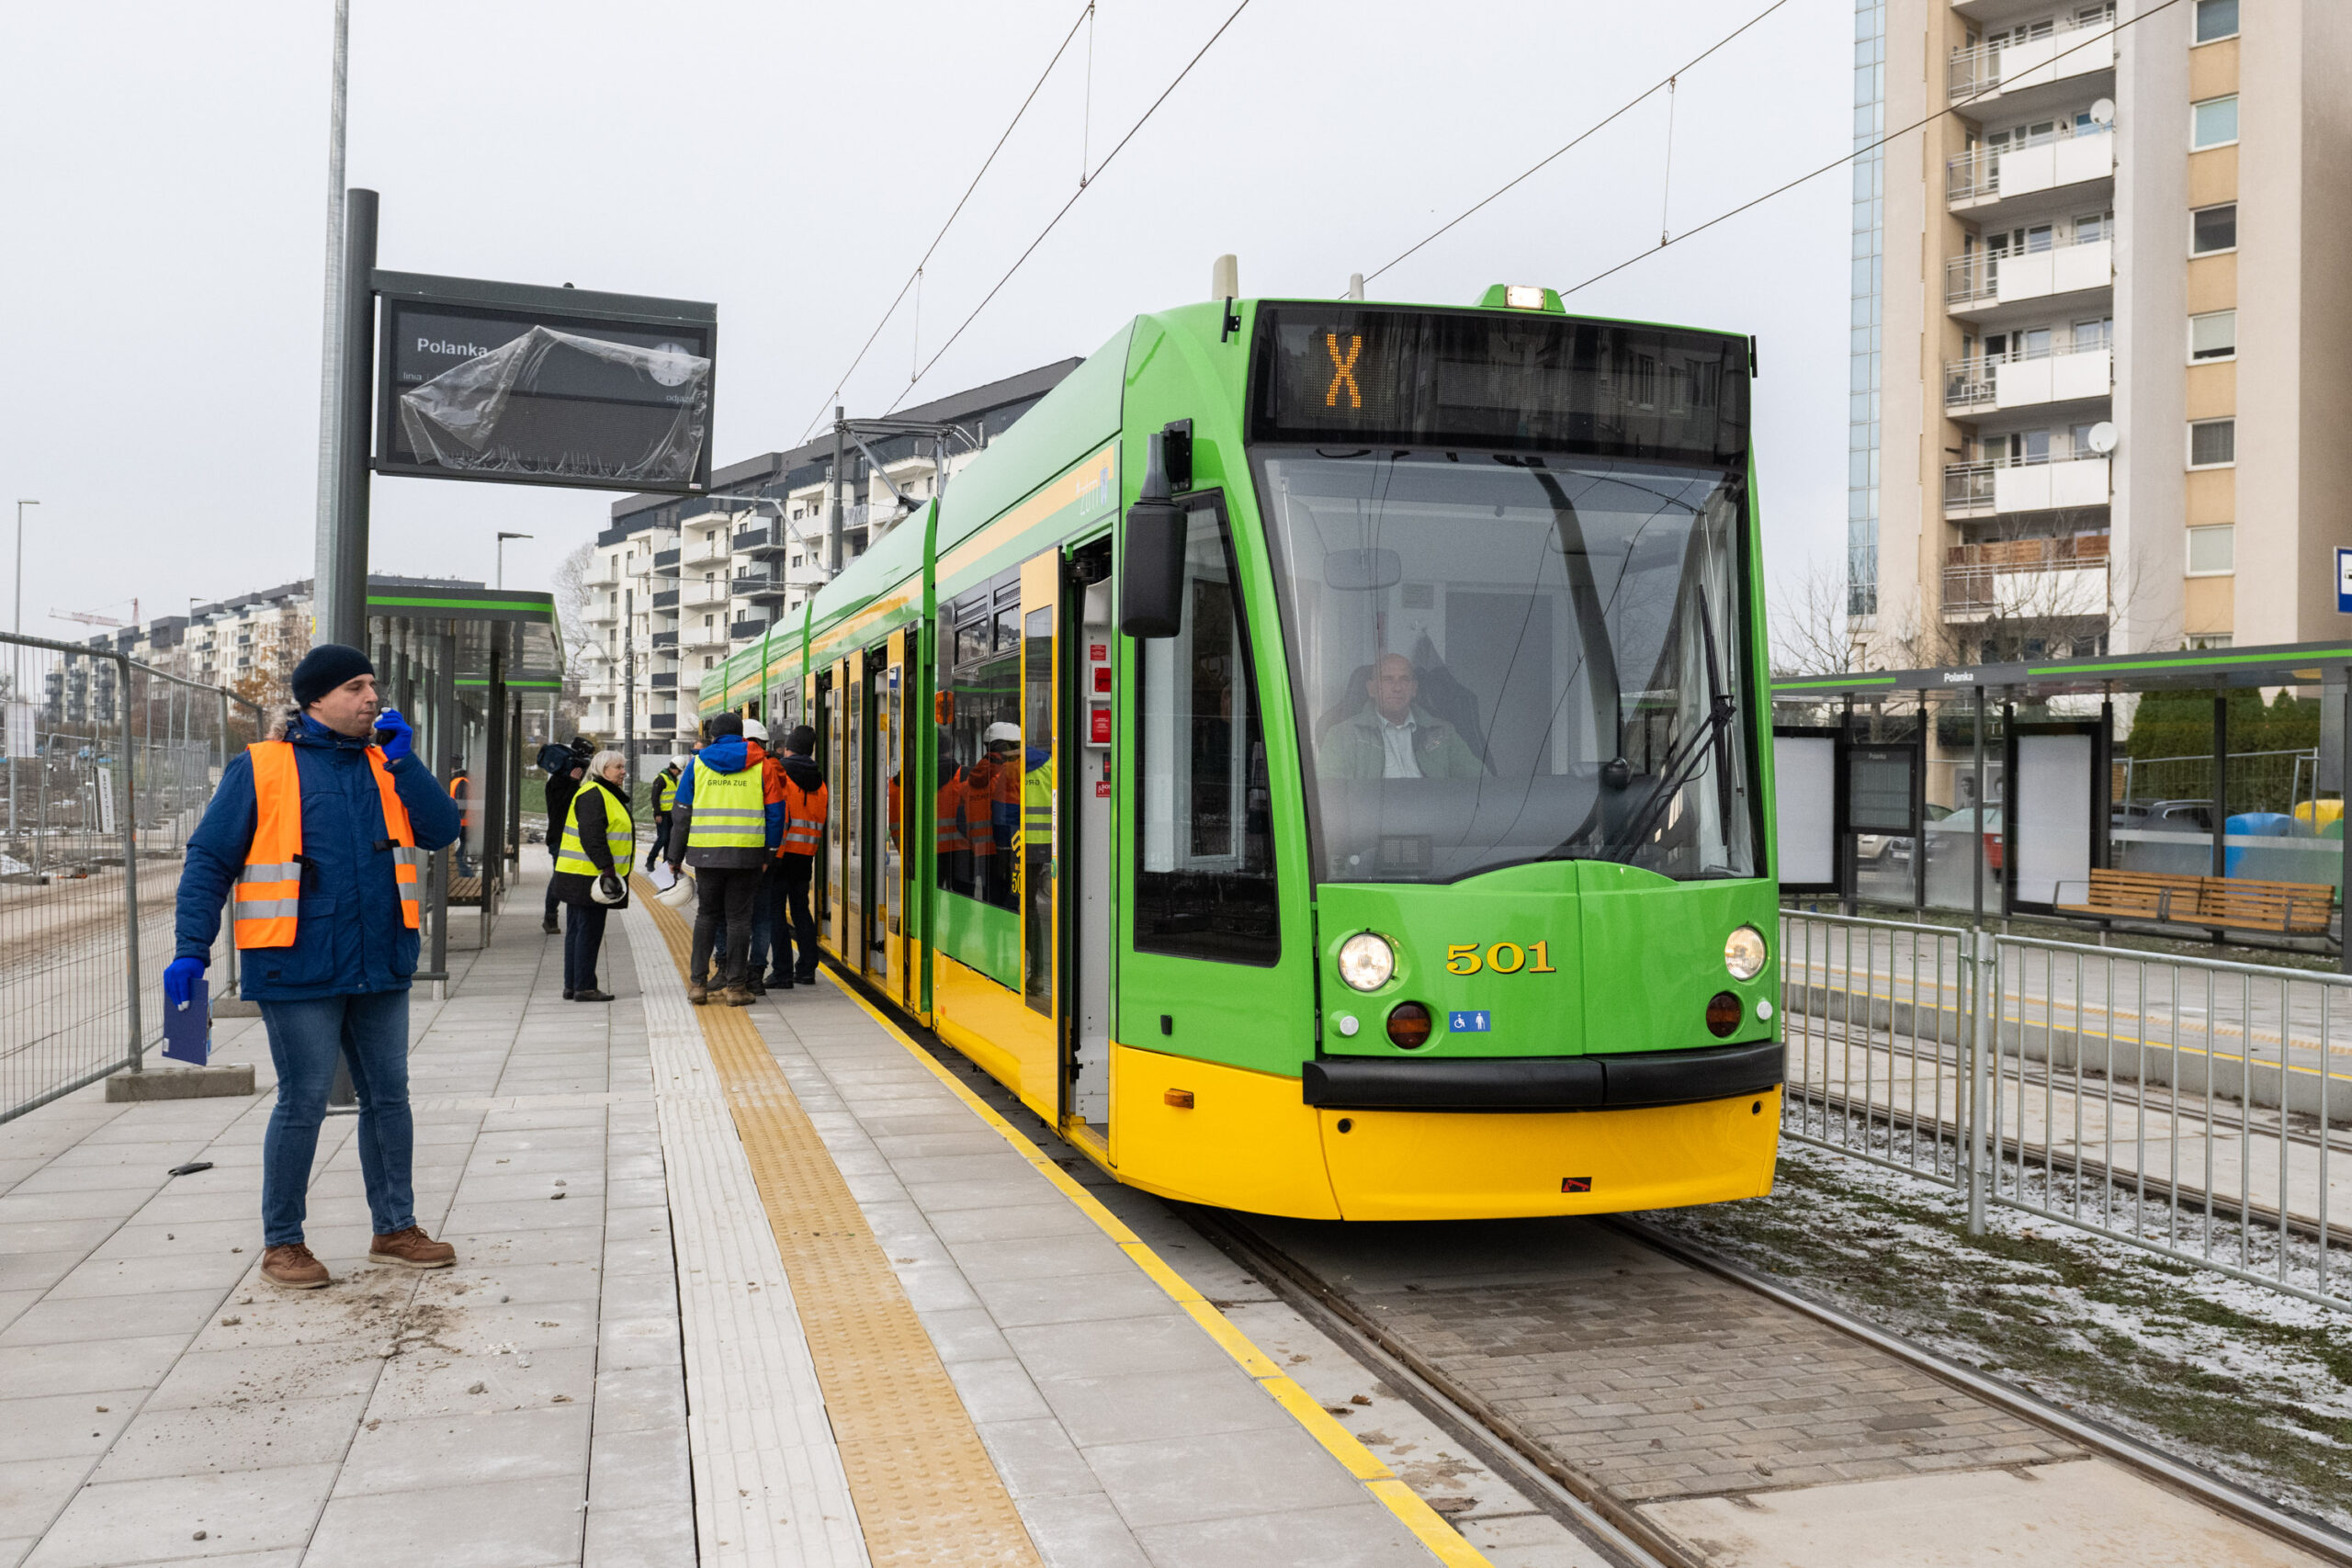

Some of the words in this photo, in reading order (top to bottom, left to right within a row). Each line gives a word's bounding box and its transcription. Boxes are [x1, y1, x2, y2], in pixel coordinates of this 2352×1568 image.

[417, 338, 488, 356] Polanka
[1327, 333, 1362, 408] X
[1943, 671, 1974, 682] Polanka
[1446, 940, 1556, 976] 501
